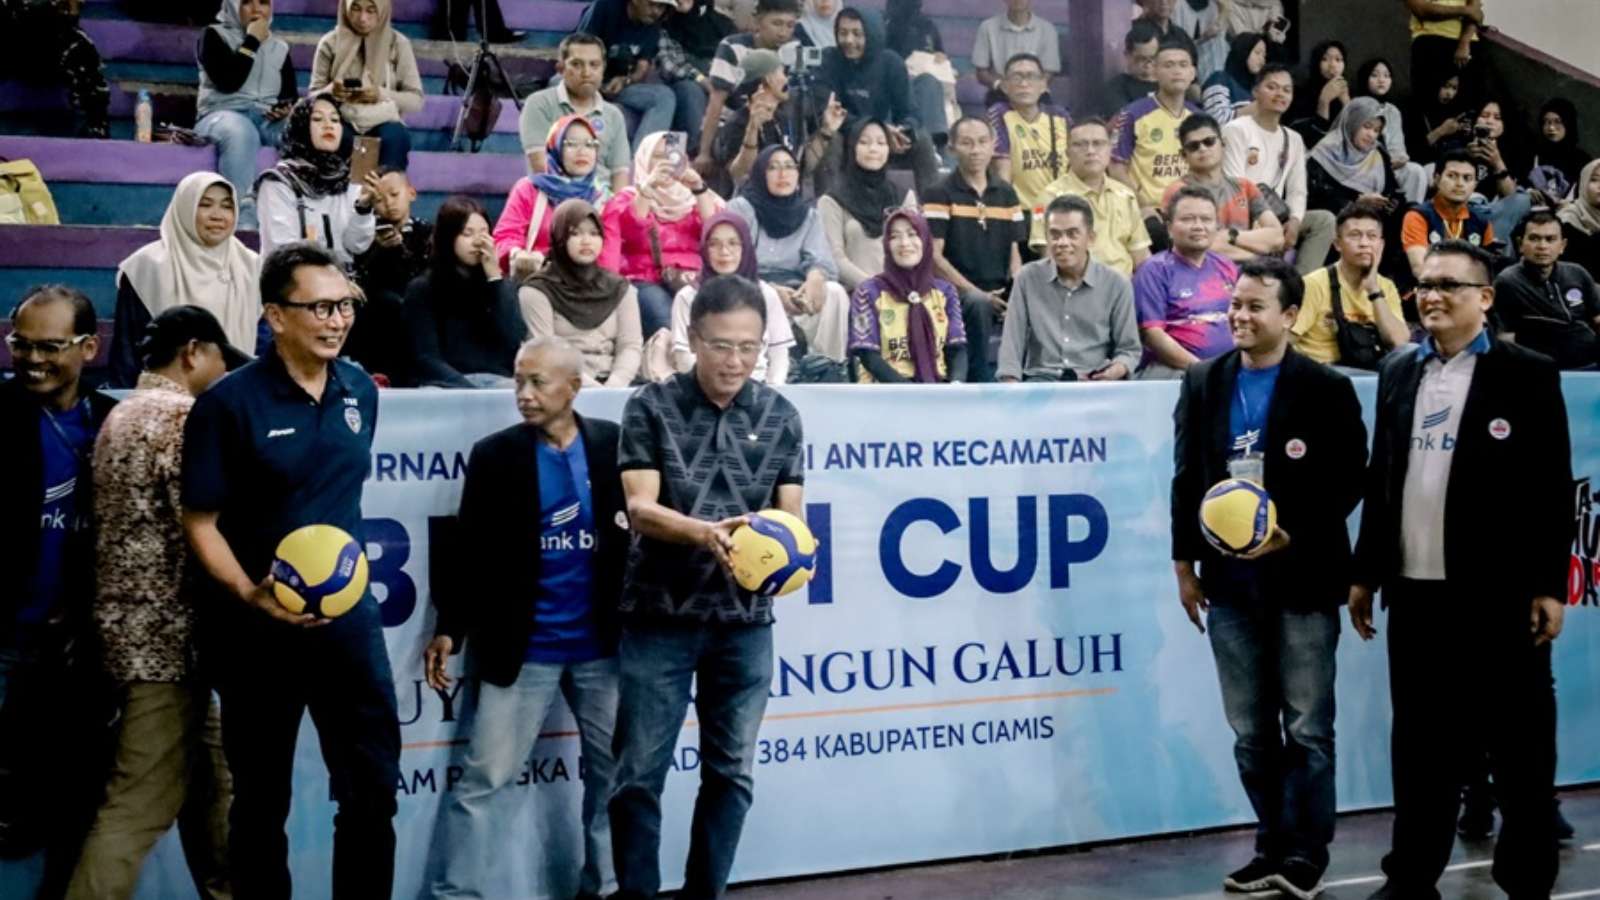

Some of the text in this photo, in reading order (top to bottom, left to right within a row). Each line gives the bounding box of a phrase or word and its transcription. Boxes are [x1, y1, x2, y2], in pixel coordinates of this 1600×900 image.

[824, 441, 923, 470] ANTAR
[933, 437, 1107, 468] KECAMATAN
[879, 494, 1110, 600] CUP
[769, 646, 938, 698] NGUN
[953, 633, 1124, 685] GALUH
[758, 738, 807, 764] 384
[815, 723, 965, 760] KABUPATEN
[972, 715, 1054, 745] CIAMIS
